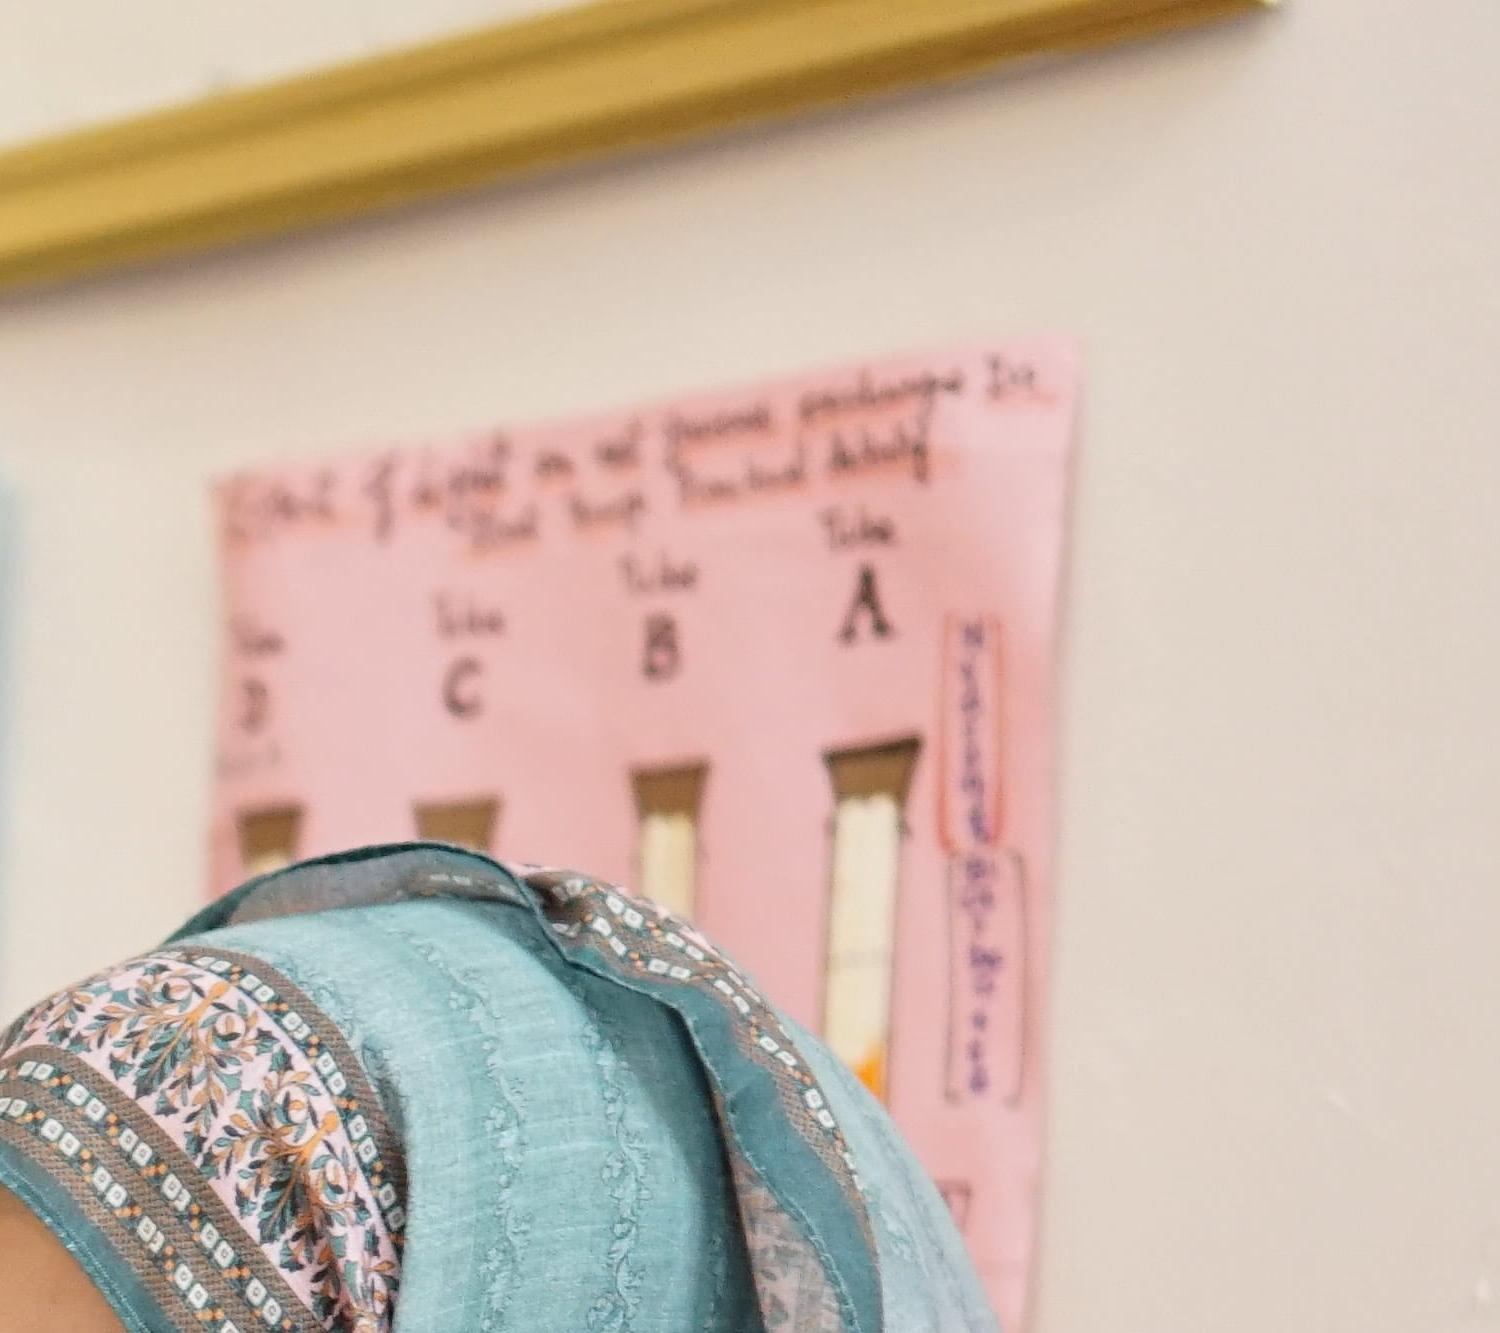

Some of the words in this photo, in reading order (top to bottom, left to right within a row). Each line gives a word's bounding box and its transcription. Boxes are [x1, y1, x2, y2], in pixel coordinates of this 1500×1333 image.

[837, 562, 894, 644] A
[642, 611, 681, 682] B
[441, 655, 485, 719] C
